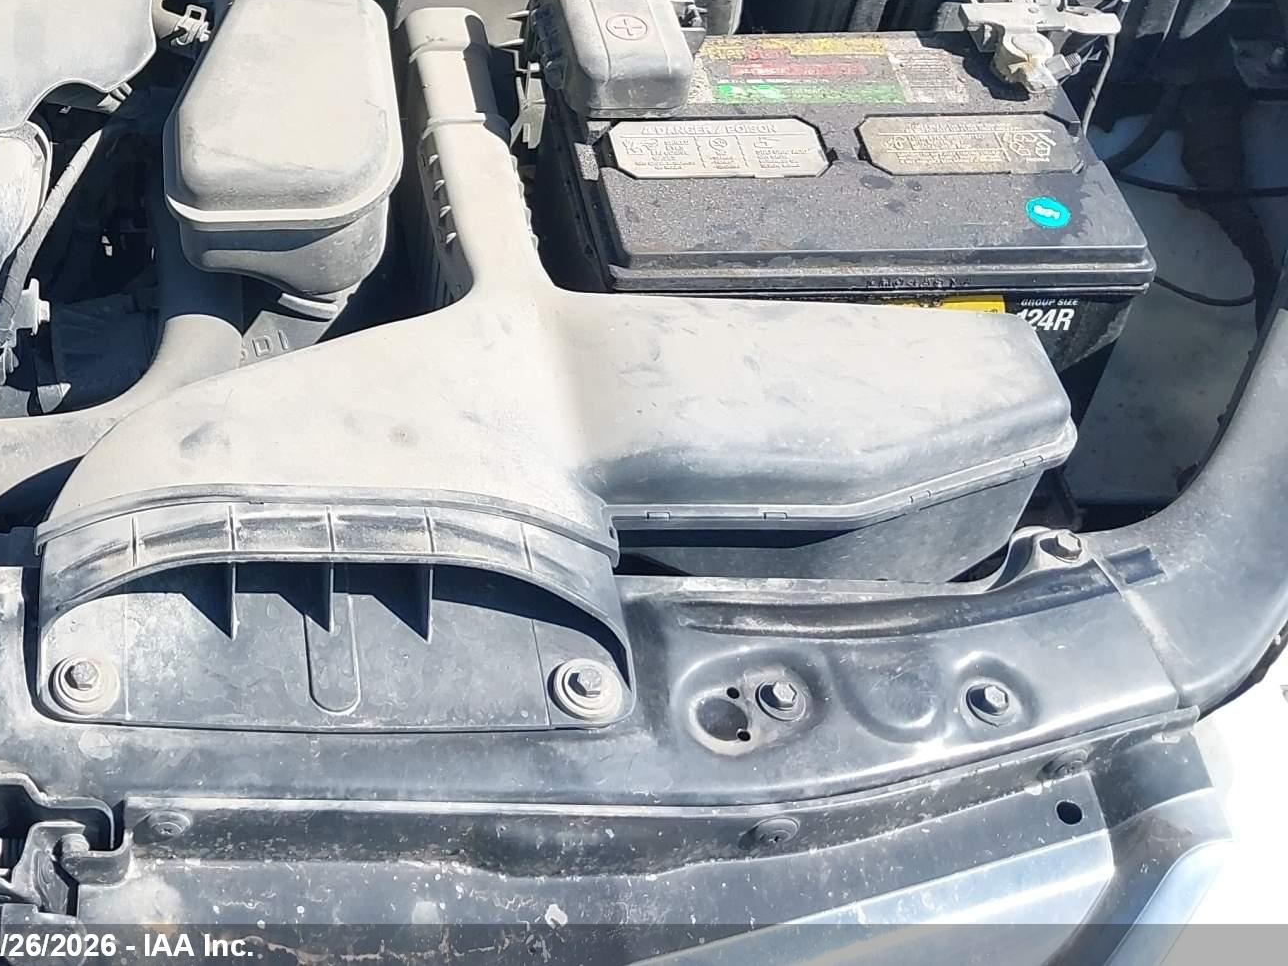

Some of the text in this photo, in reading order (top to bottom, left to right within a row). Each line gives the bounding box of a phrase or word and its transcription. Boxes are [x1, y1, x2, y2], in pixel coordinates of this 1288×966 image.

[654, 124, 713, 136] DANGER
[725, 123, 777, 134] POISON
[1020, 297, 1079, 307] GROUP SIZE
